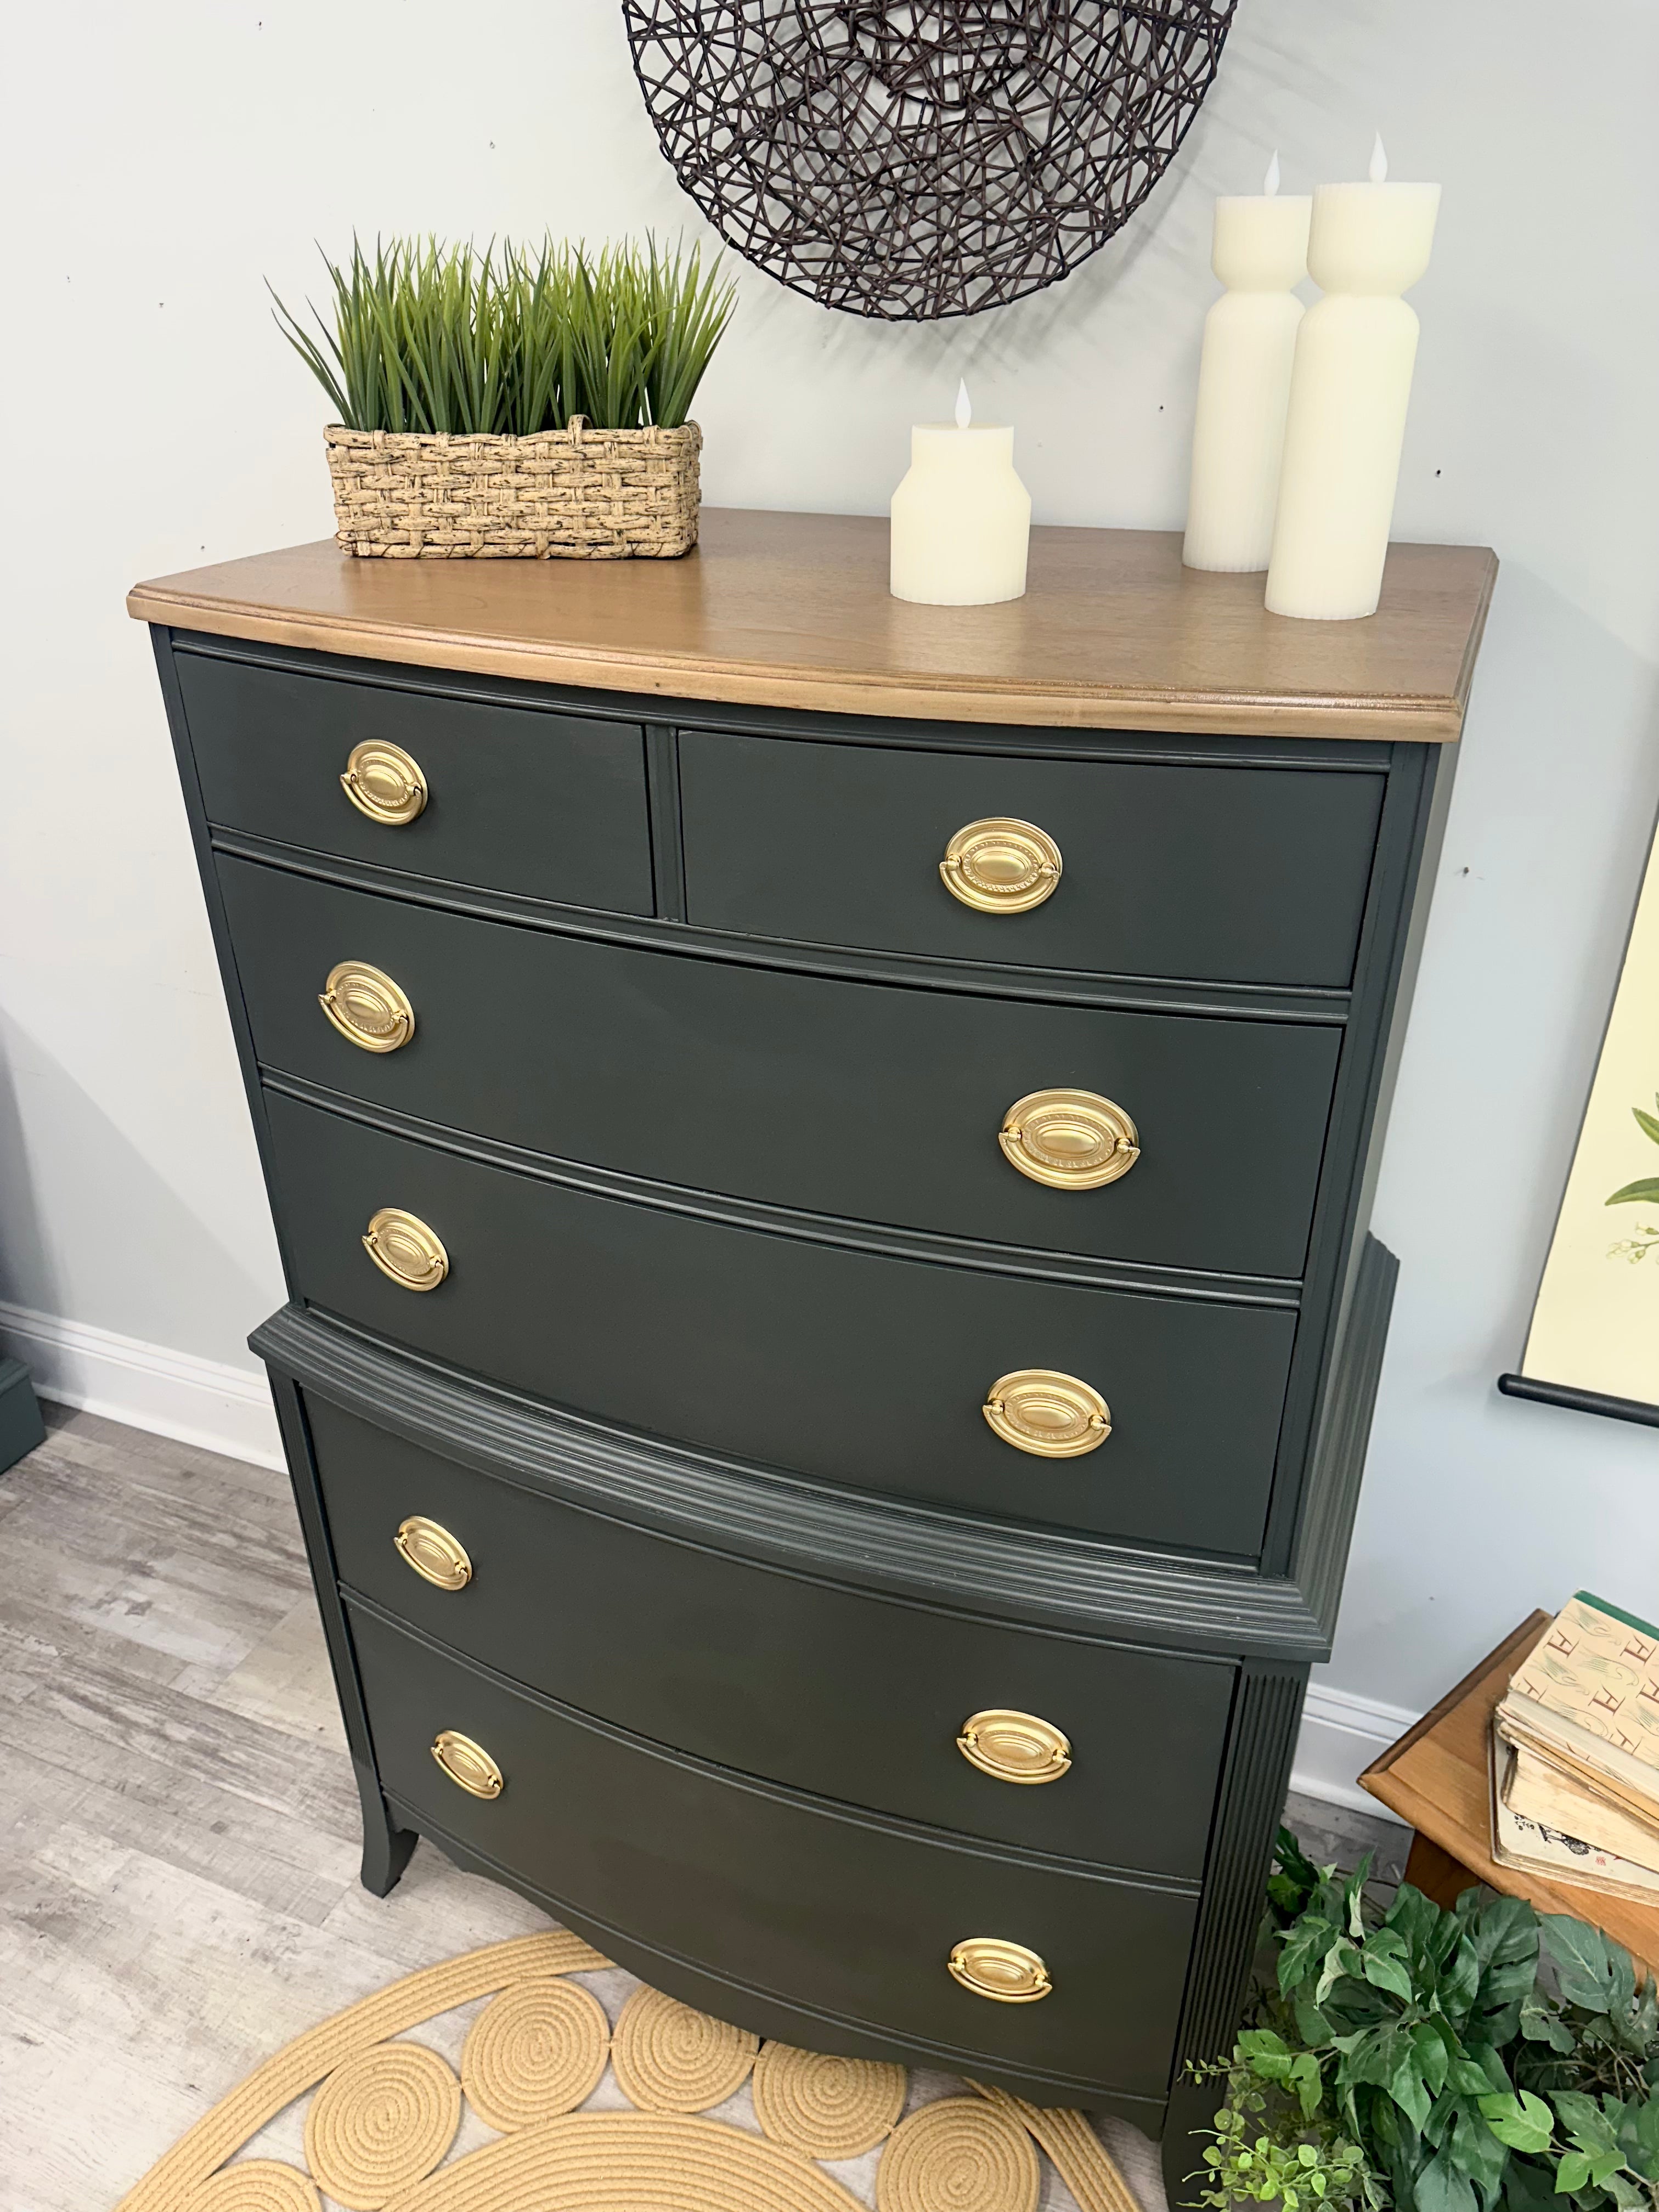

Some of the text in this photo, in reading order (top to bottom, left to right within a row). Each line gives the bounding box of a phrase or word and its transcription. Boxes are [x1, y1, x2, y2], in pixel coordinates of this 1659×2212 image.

[1542, 1628, 1580, 1658] A
[1620, 1632, 1658, 1667] A
[1588, 1682, 1626, 1716] A
